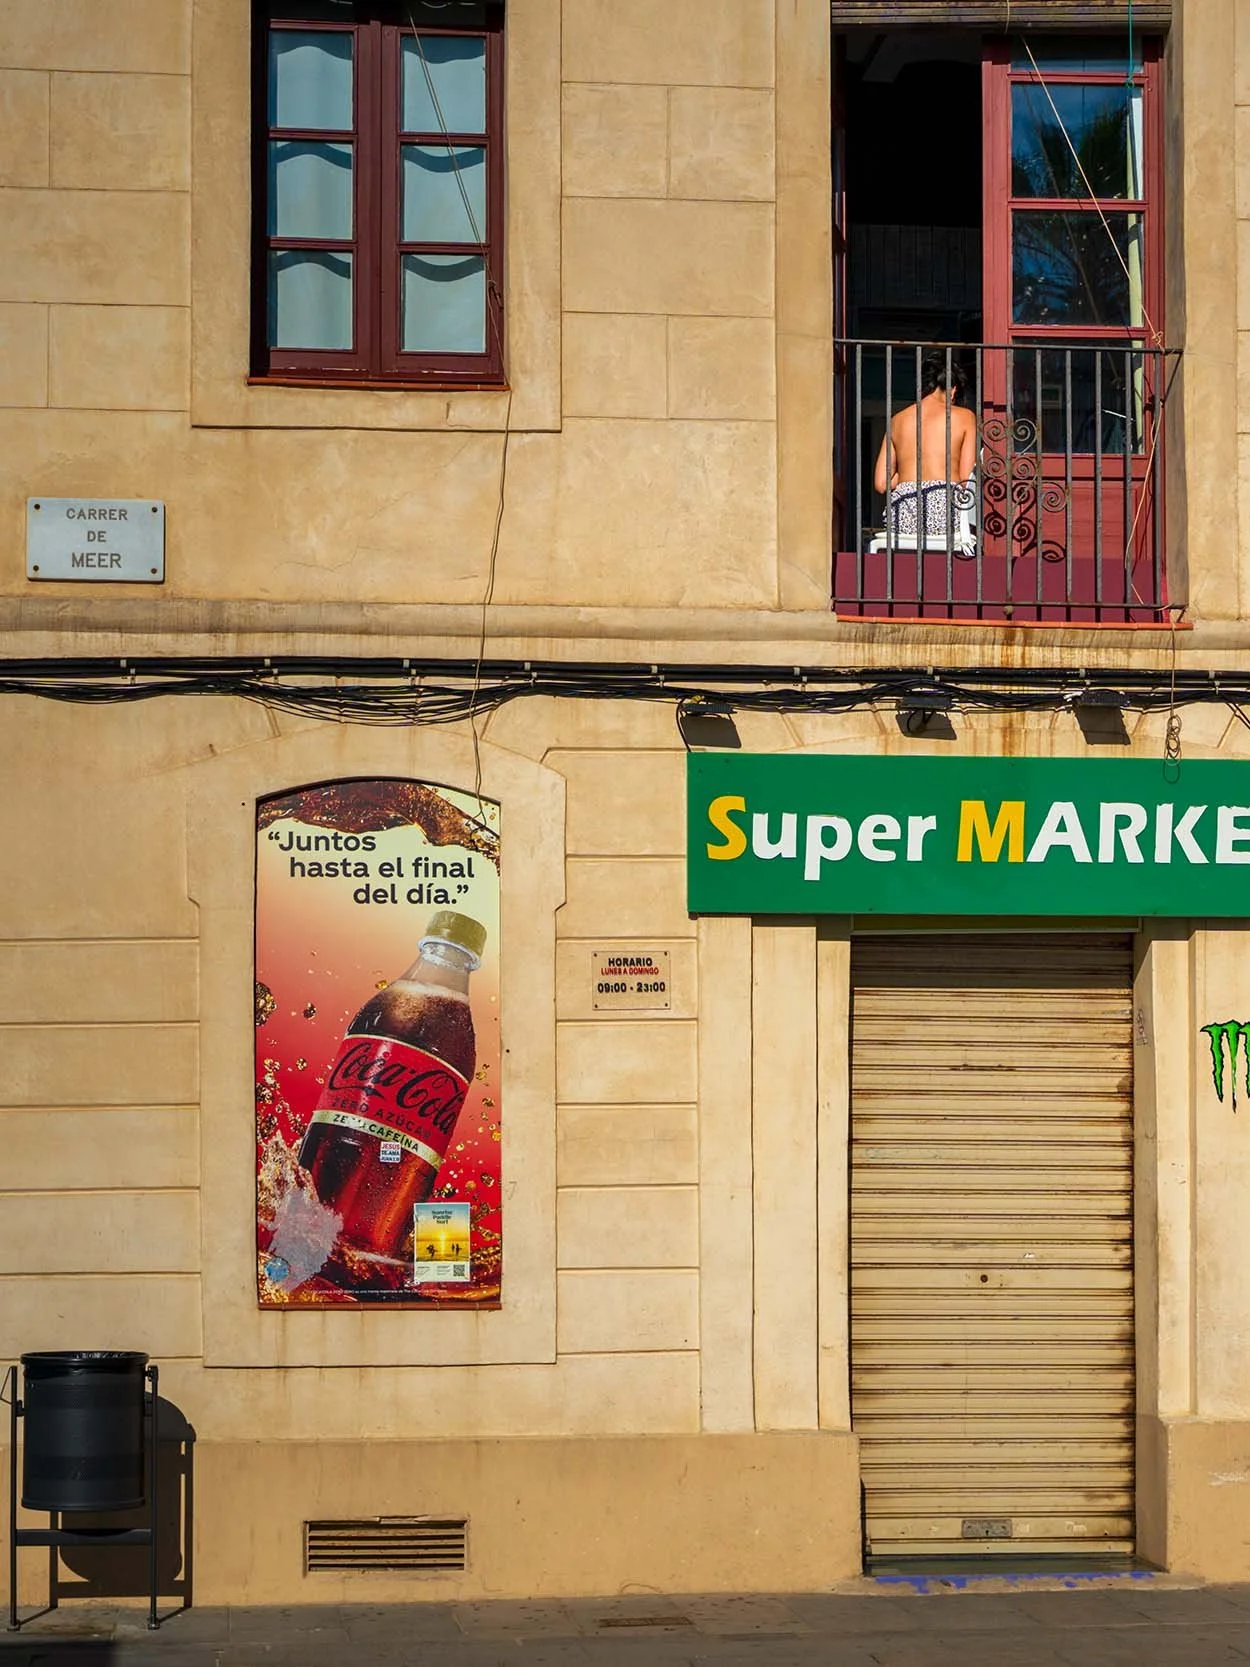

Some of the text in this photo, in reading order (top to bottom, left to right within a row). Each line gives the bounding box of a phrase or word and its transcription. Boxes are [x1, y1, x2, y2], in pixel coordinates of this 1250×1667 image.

[66, 508, 128, 521] CARRER
[86, 530, 107, 543] DE
[71, 552, 122, 569] MEER
[706, 795, 937, 881] Super
[290, 857, 475, 878] hasta el final
[353, 883, 398, 904] del
[608, 957, 653, 967] HORARIO
[601, 967, 622, 976] LUNES
[629, 967, 660, 976] DOMINGO
[597, 982, 628, 993] 09:00
[636, 982, 667, 993] 23:00
[332, 1098, 369, 1113] ZERO
[333, 1113, 419, 1152] ZE CAFEÍNA
